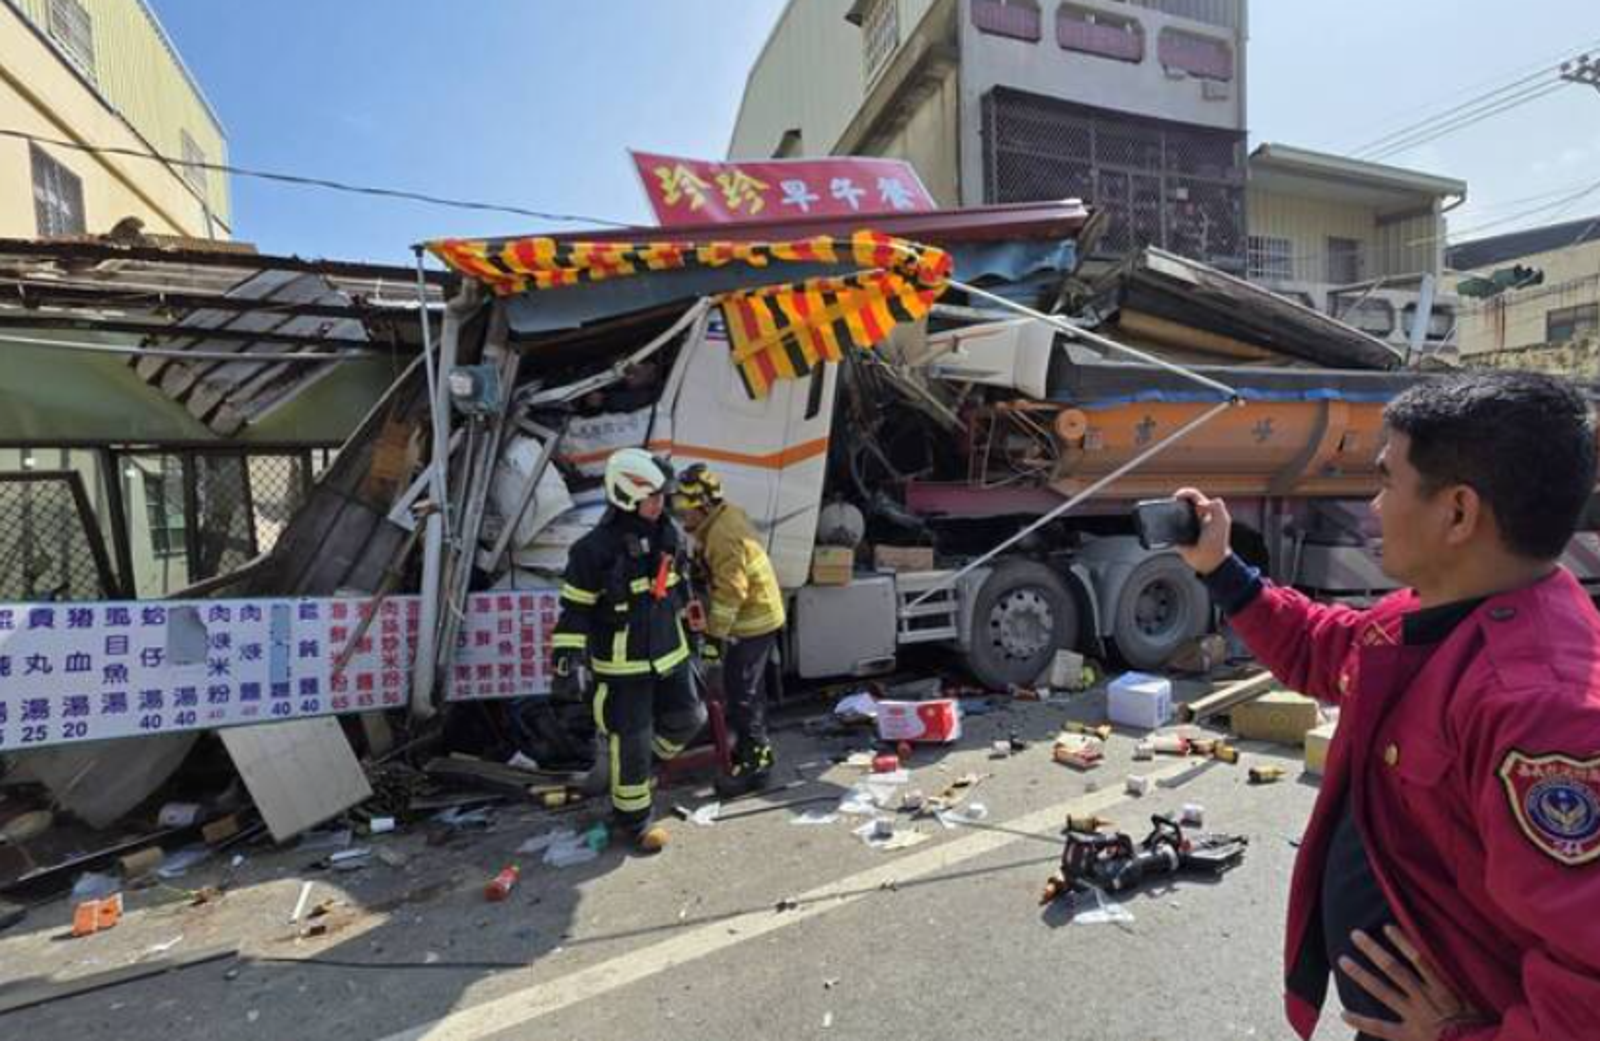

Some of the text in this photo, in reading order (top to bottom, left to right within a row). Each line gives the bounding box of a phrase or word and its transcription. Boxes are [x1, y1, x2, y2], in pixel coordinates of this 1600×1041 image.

[271, 701, 291, 715] 40
[300, 698, 320, 713] 40
[140, 714, 162, 729] 40
[174, 710, 196, 725] 40
[21, 725, 47, 742] 25
[62, 721, 87, 738] 20
